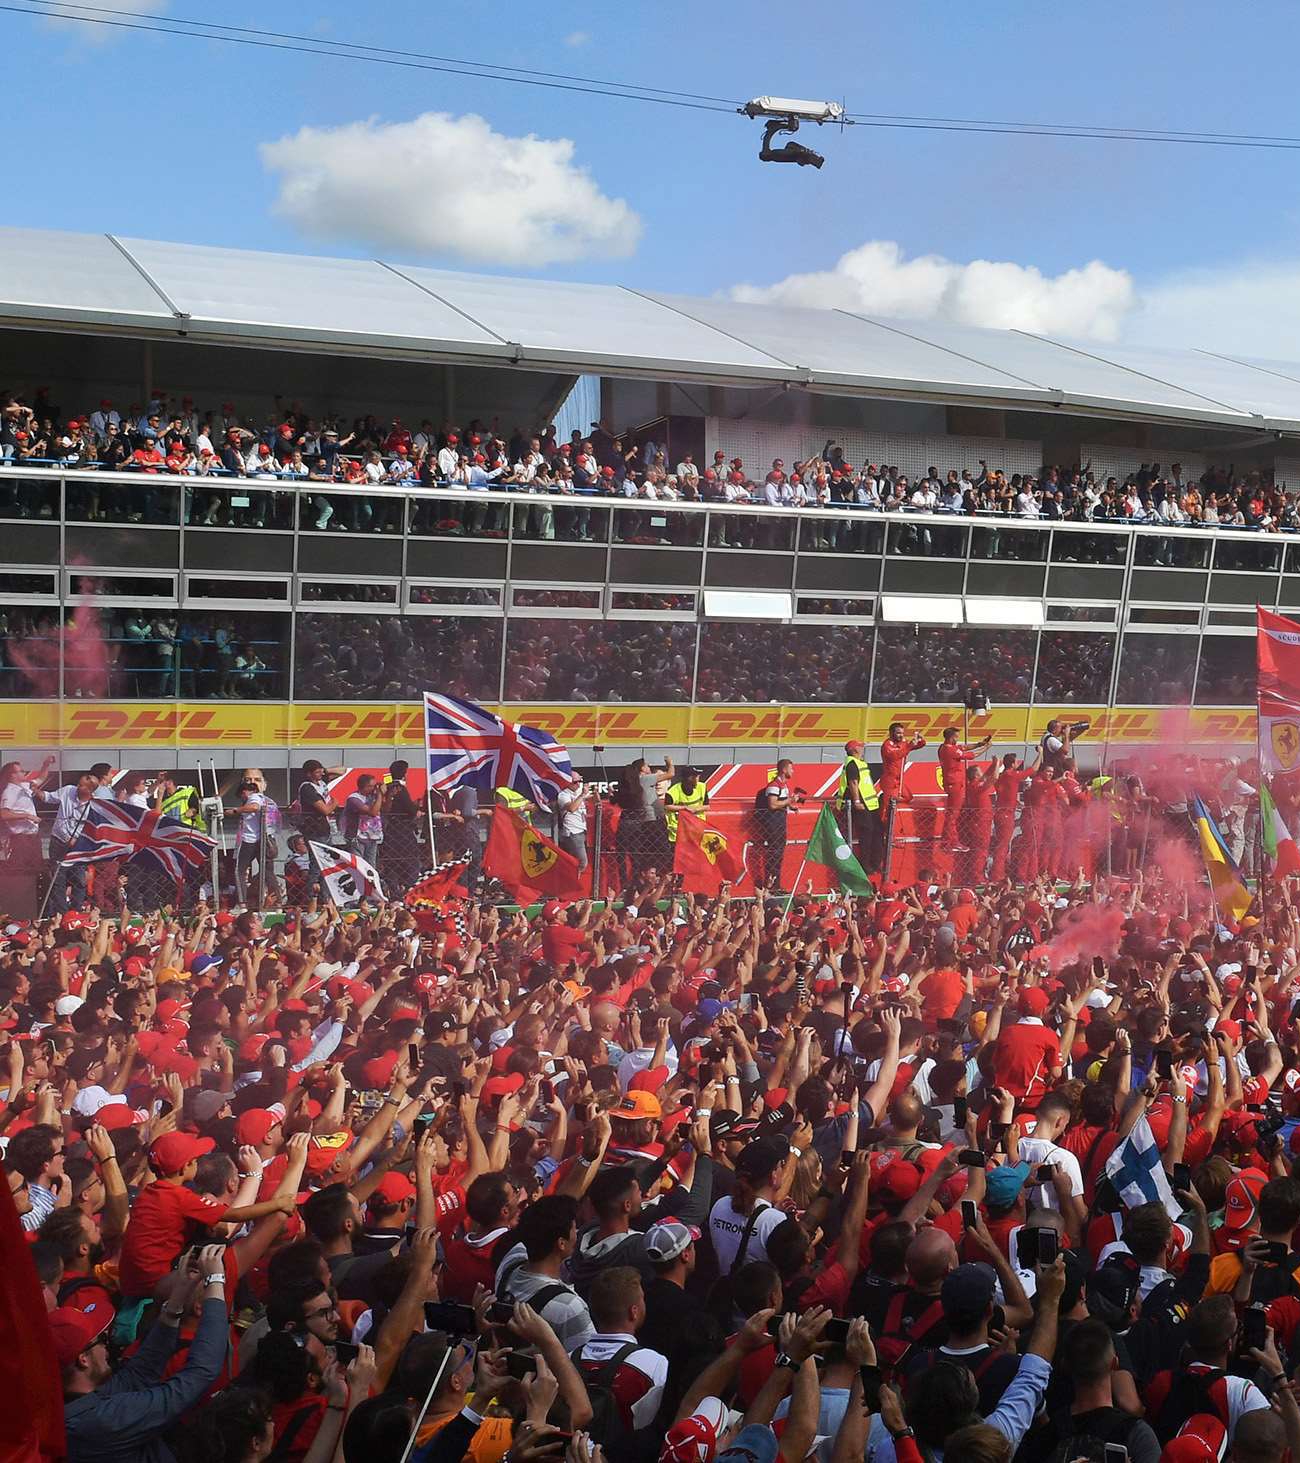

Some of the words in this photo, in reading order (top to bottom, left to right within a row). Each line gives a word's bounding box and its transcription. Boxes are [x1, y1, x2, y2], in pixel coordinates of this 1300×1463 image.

[68, 711, 224, 739] DHL
[708, 713, 829, 738] DHL
[1200, 715, 1257, 737] DH
[714, 1217, 758, 1237] PETRONS
